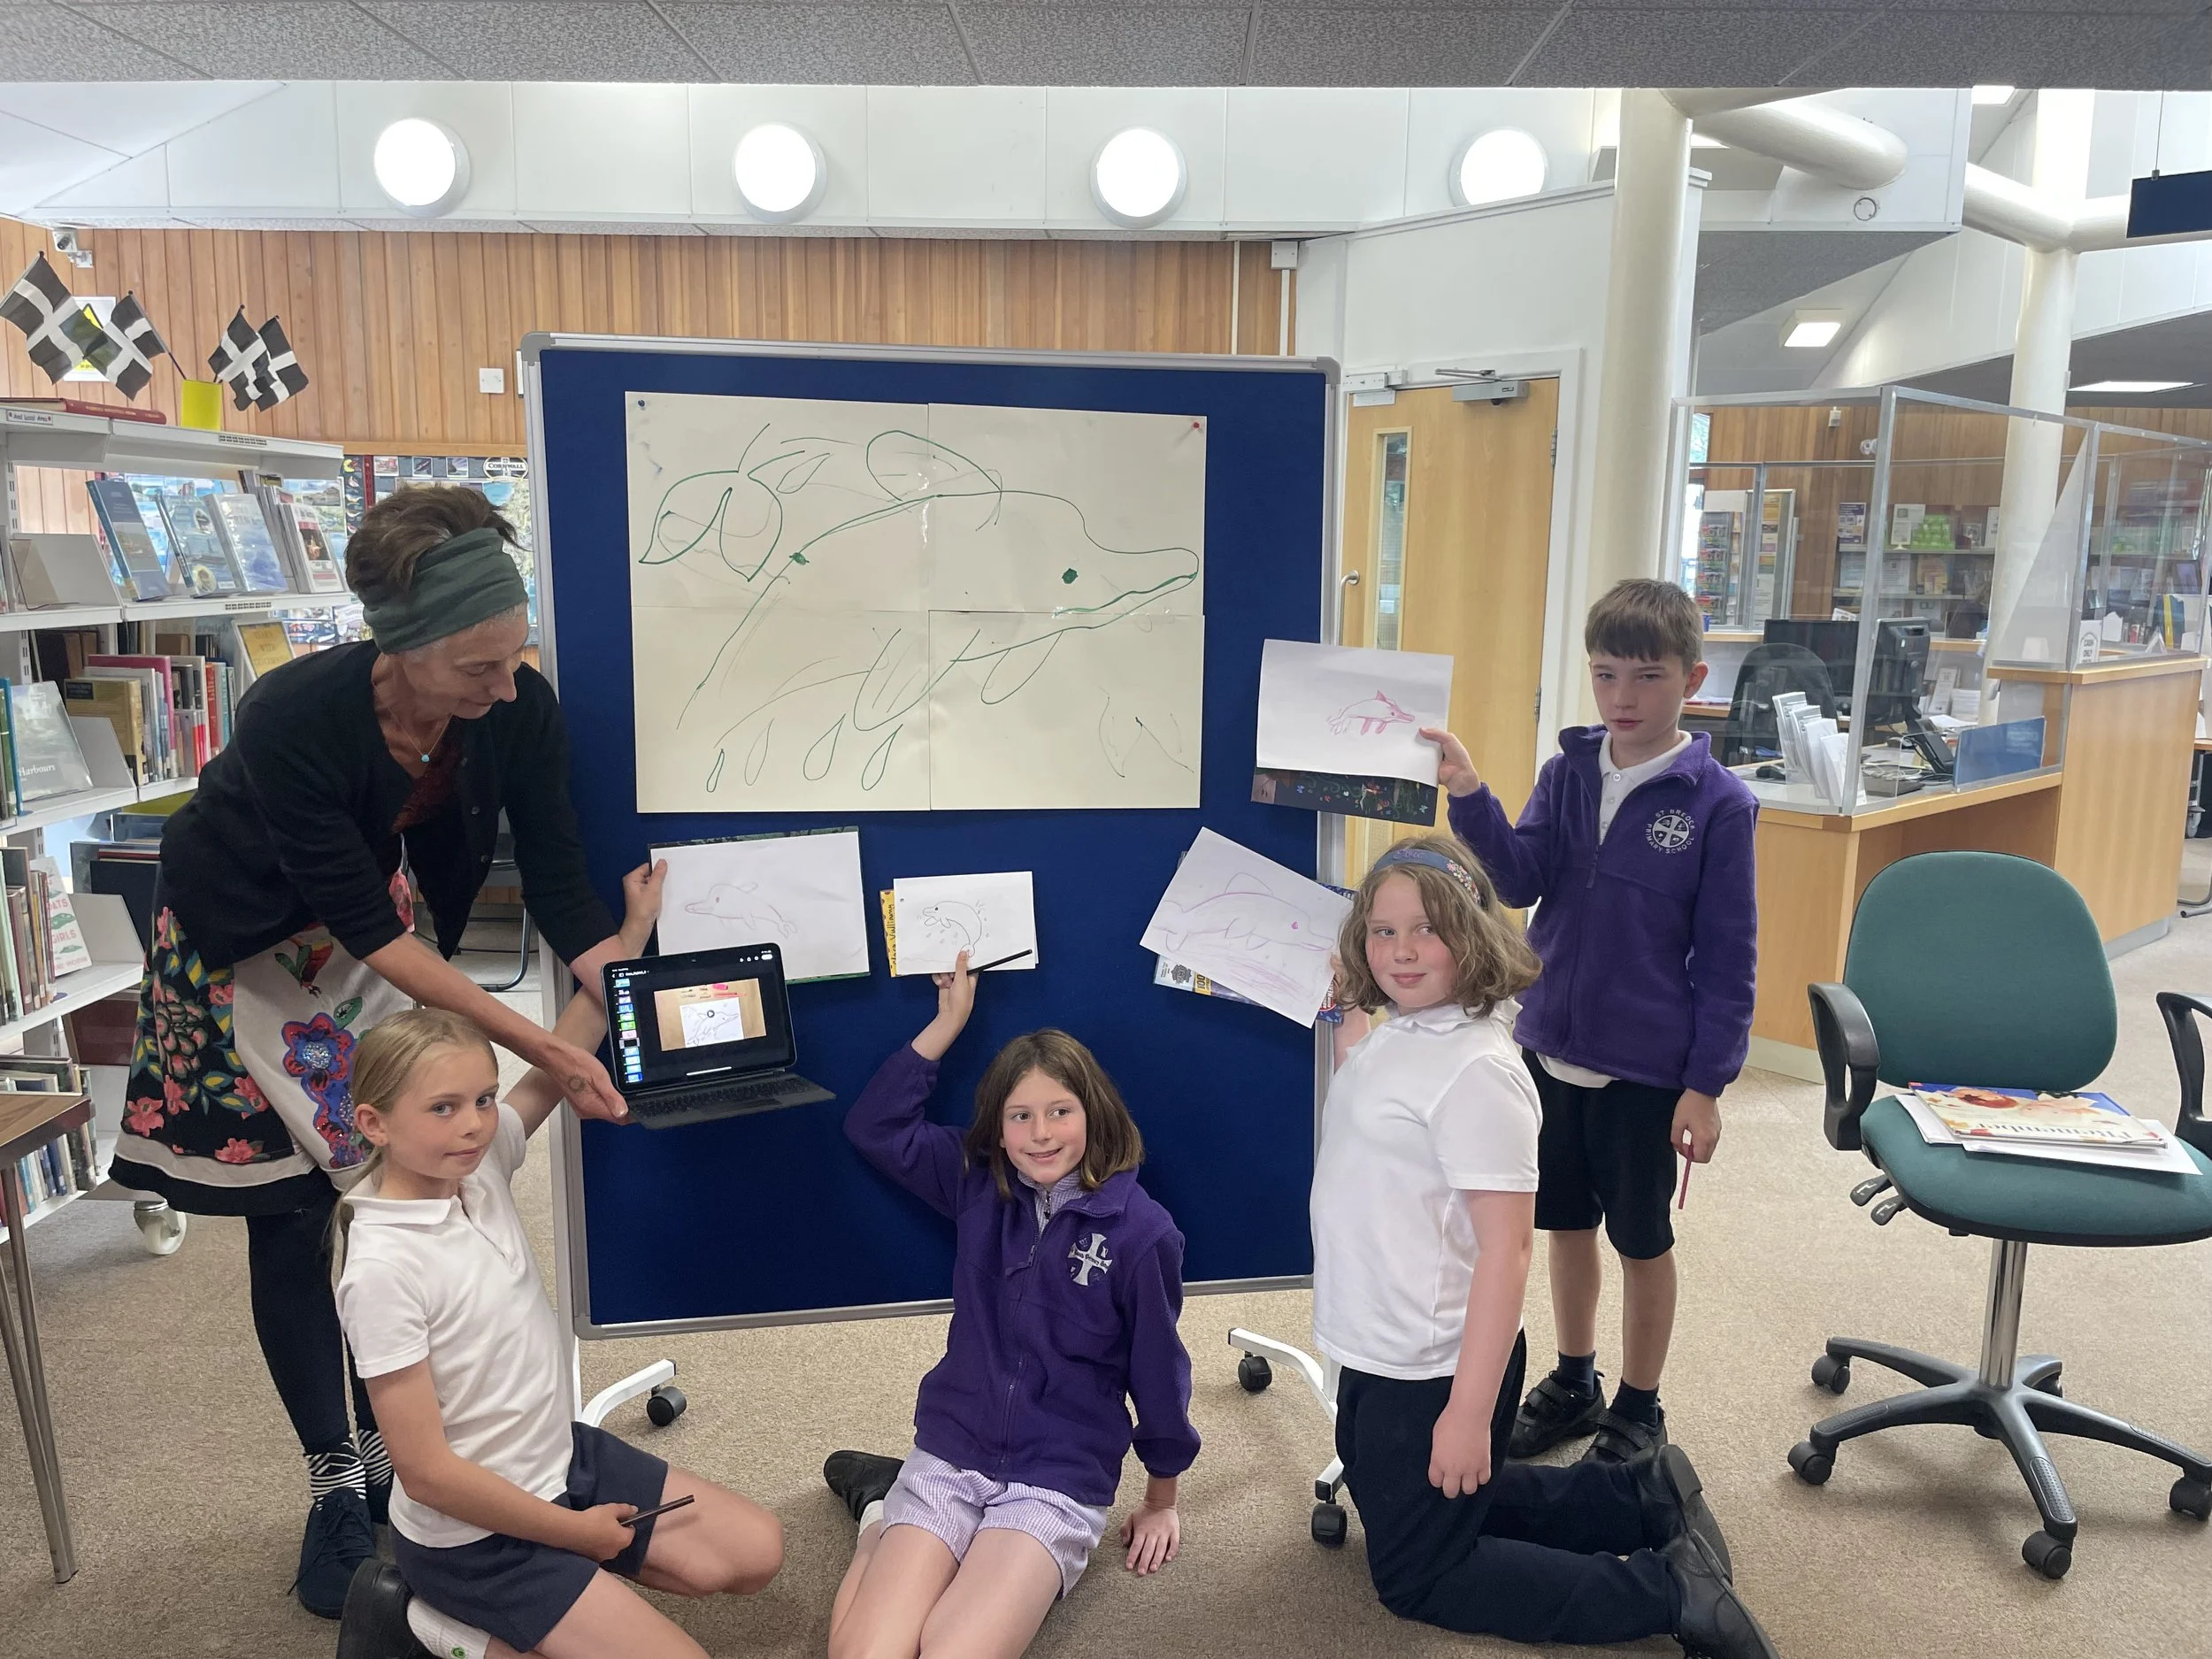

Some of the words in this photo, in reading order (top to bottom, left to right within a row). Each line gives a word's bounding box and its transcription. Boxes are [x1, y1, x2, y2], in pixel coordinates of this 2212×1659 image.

[19, 764, 56, 777] Harbours
[1655, 810, 1664, 818] ST
[1670, 809, 1695, 830] BREOCK
[1645, 823, 1663, 853] PRIMARY
[1665, 837, 1694, 854] SCHOOL
